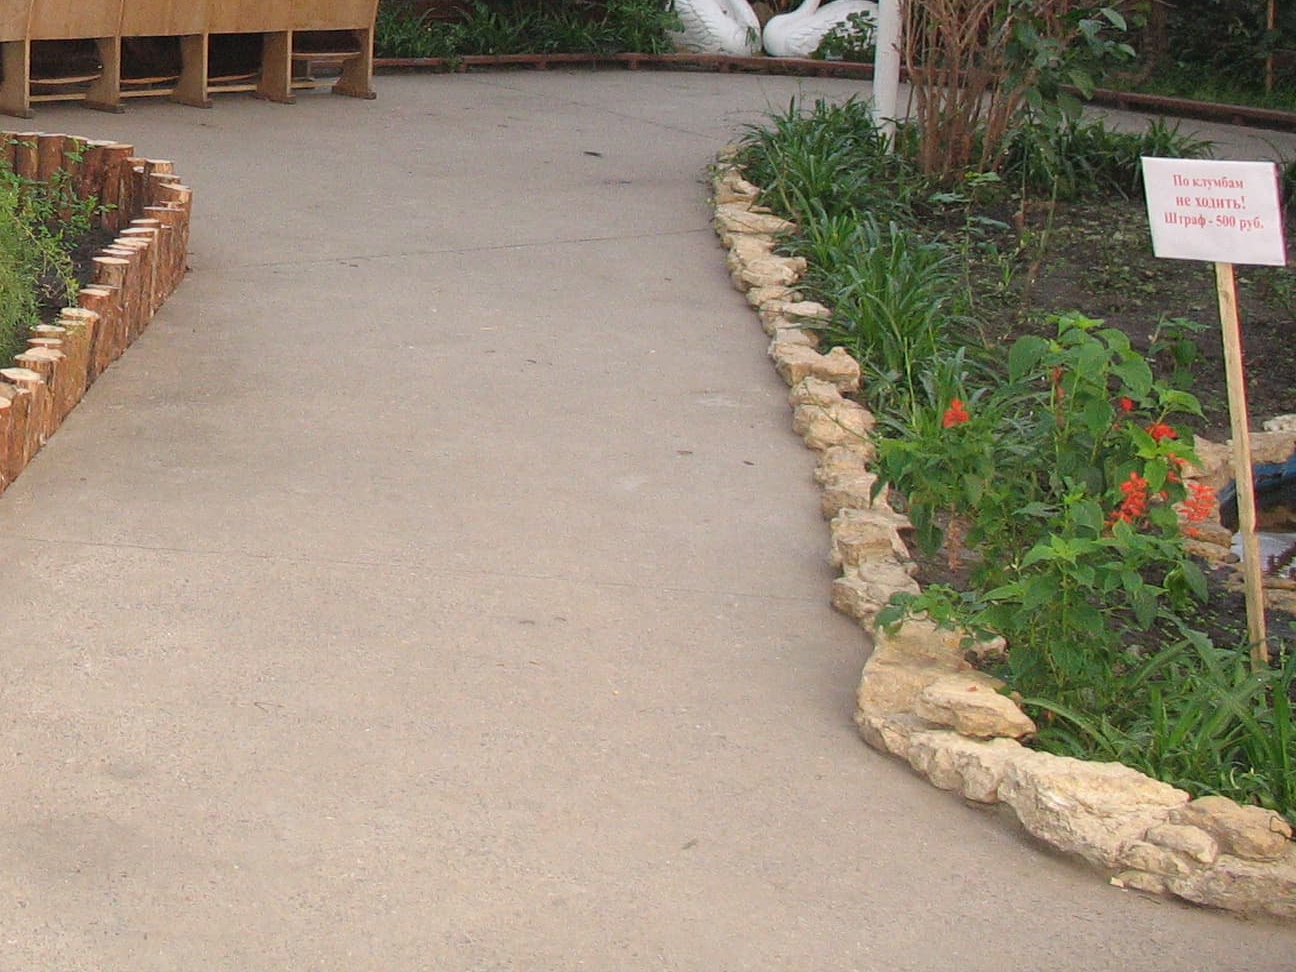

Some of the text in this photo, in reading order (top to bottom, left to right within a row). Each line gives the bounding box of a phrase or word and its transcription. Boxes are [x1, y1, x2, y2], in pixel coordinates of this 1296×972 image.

[1173, 175, 1244, 189] По клумбам
[1175, 195, 1247, 210] не ходить!
[1165, 212, 1206, 228] Штраф
[1216, 215, 1236, 227] 500
[1239, 217, 1264, 231] руб.
